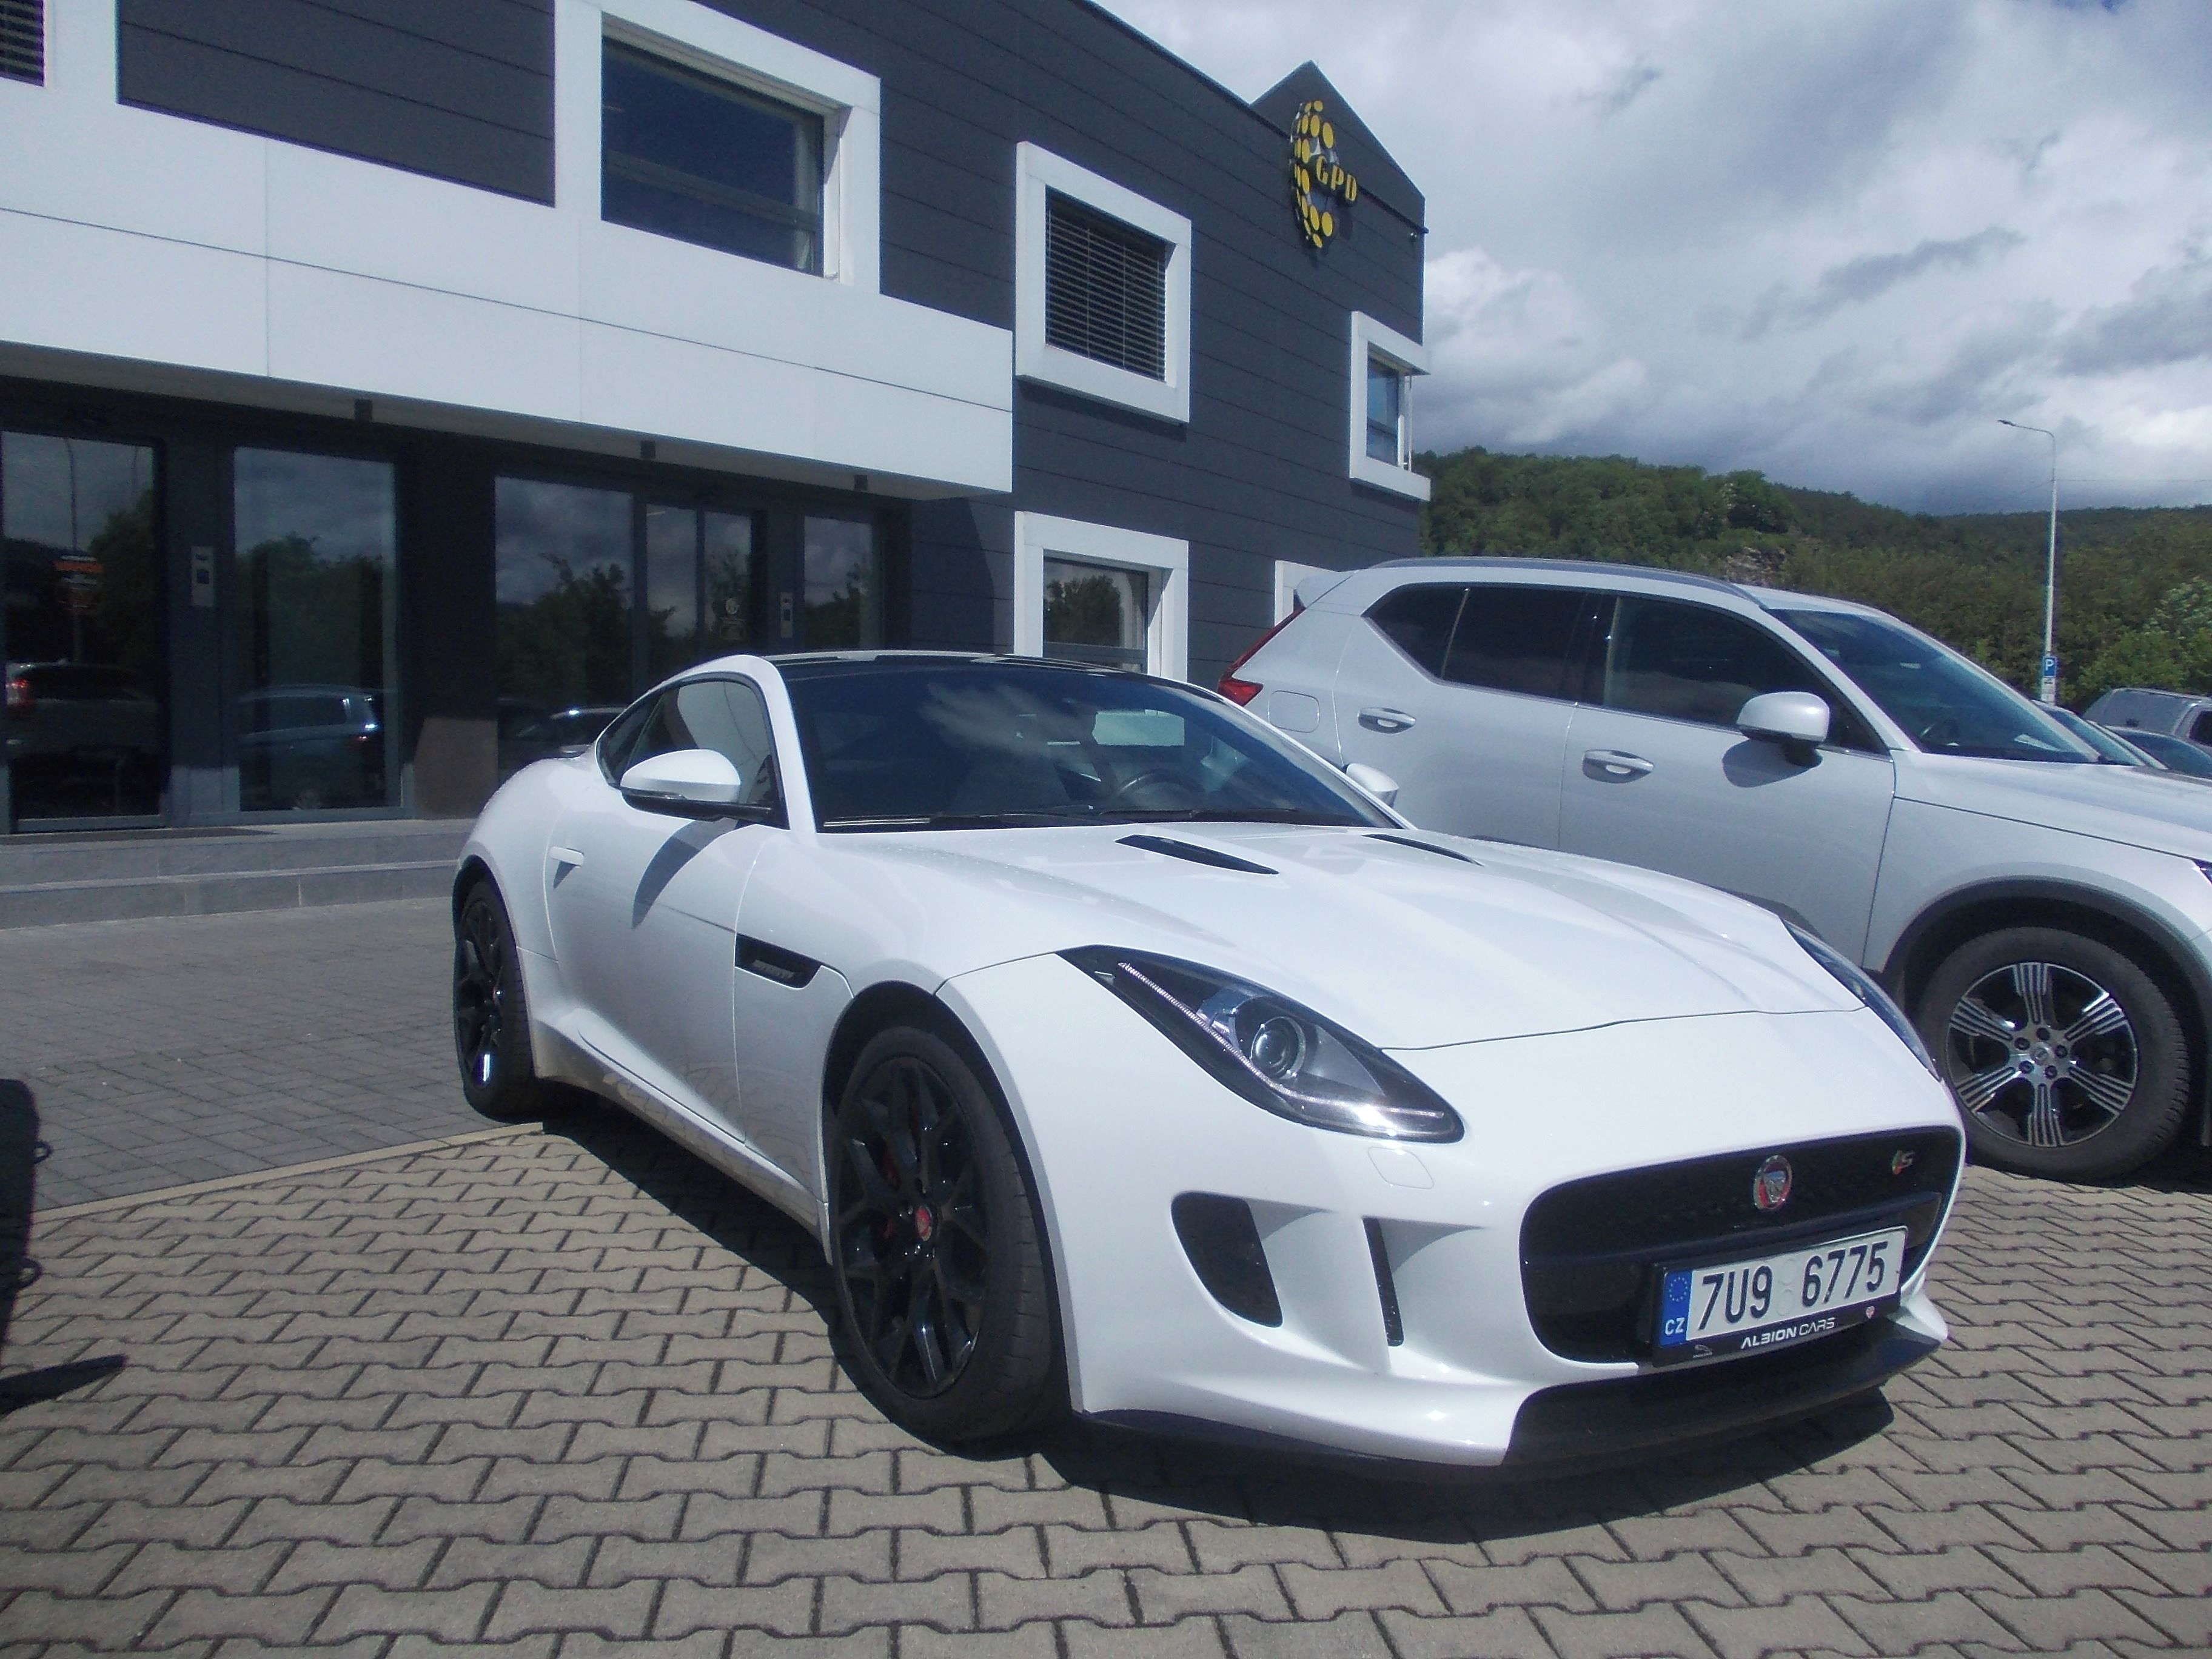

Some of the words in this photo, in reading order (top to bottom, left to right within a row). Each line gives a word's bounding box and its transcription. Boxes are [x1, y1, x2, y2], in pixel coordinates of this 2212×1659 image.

[2045, 659, 2054, 671] P
[1697, 1265, 1773, 1331] 7U9
[1801, 1241, 1888, 1307] 6775
[1664, 1317, 1684, 1336] CZ
[1741, 1327, 1797, 1350] ALBION
[1798, 1317, 1835, 1336] CARS
